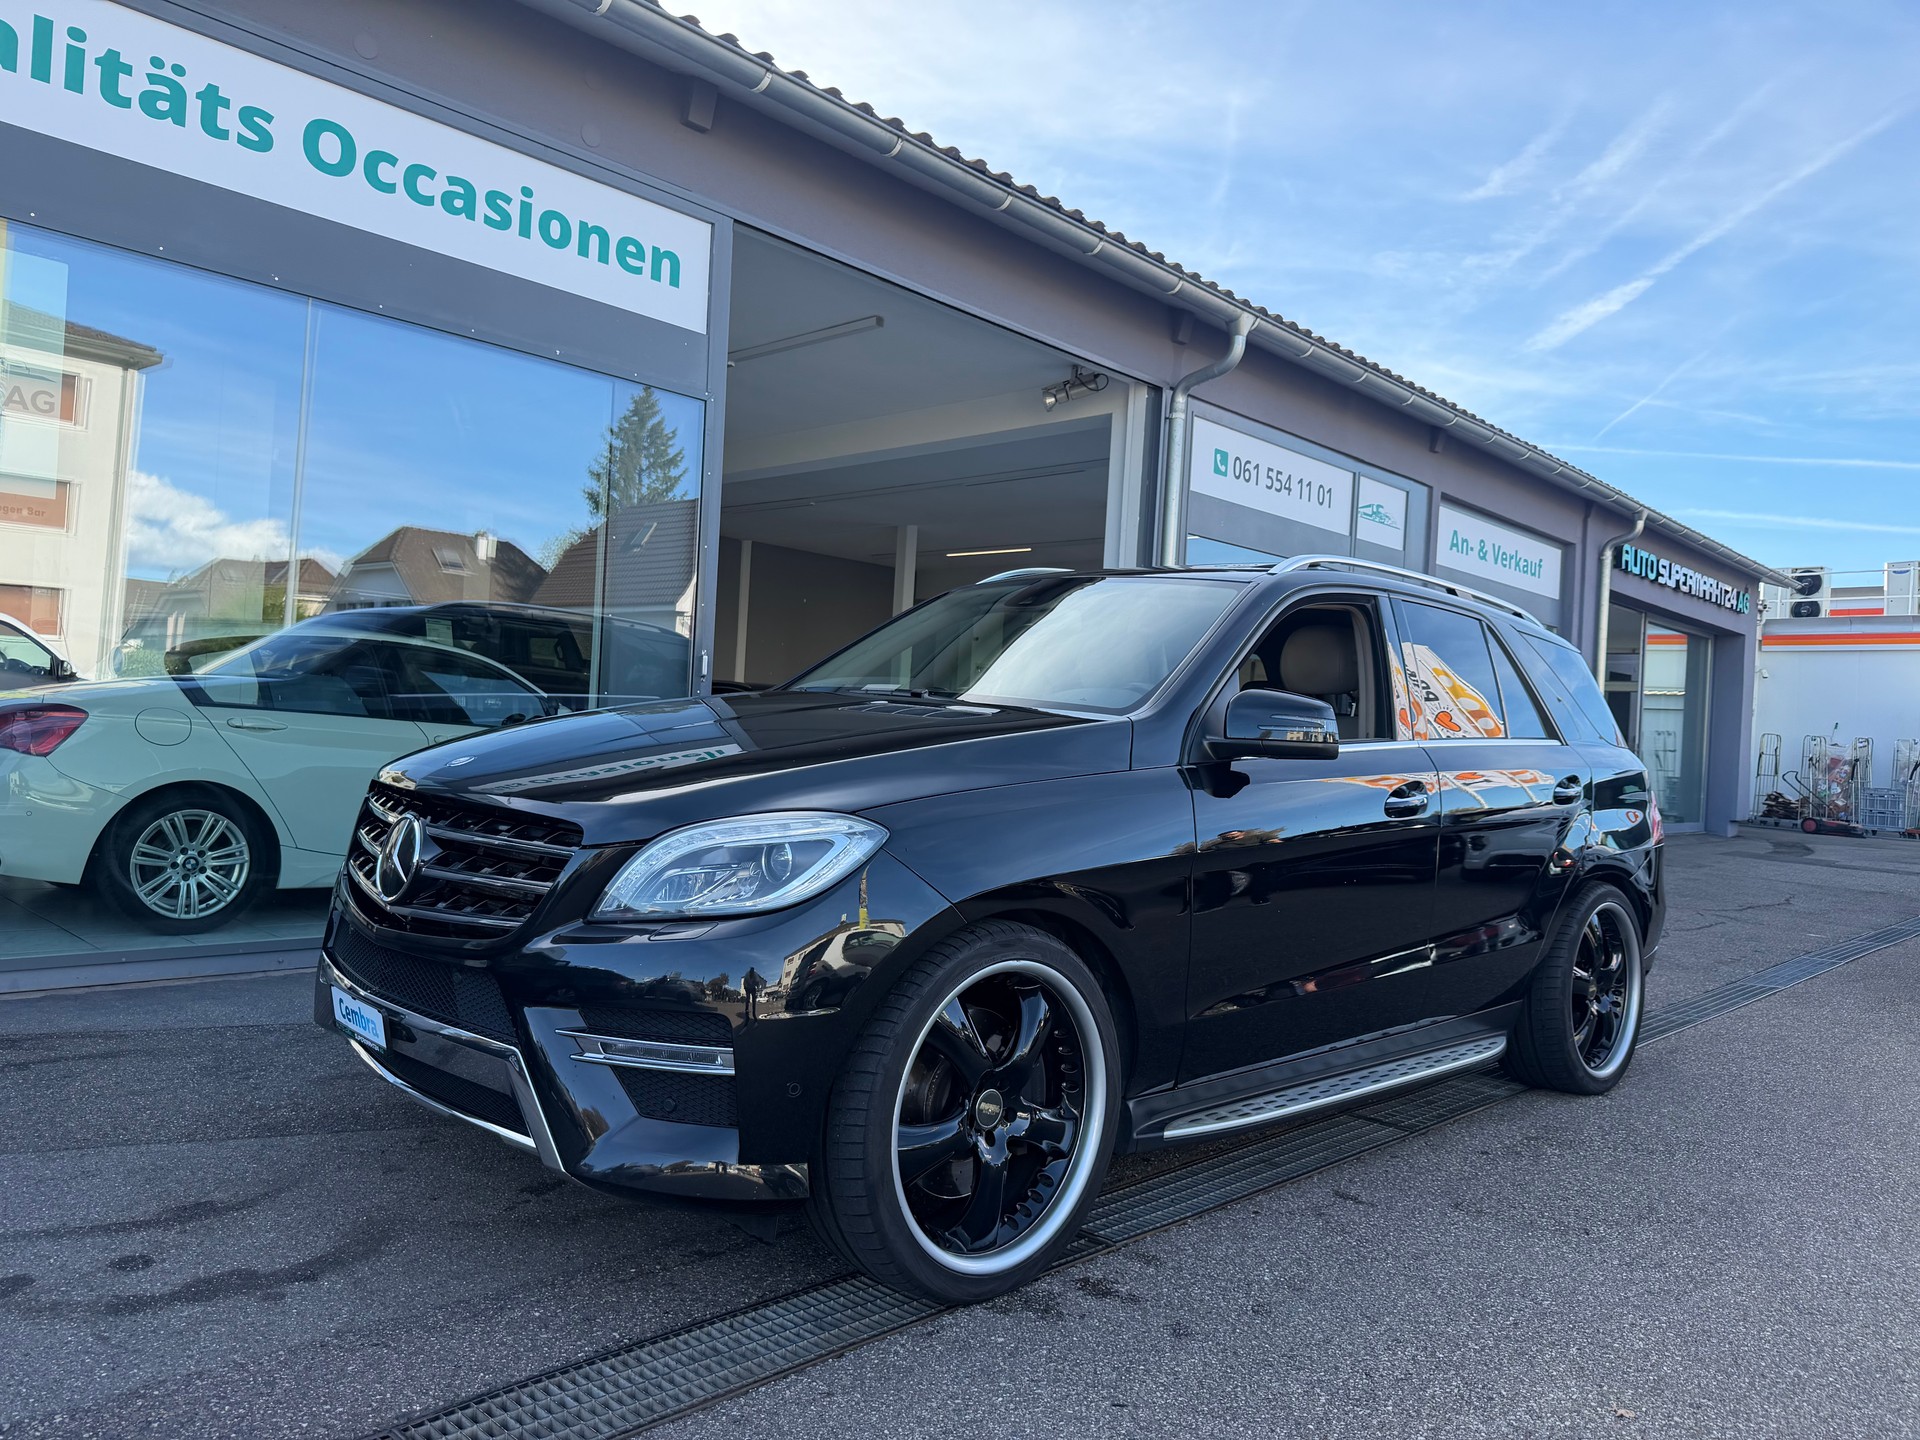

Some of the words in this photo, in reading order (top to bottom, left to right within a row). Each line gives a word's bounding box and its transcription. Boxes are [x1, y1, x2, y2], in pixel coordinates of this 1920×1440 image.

[302, 118, 682, 290] Occasionen
[2, 385, 56, 414] AG
[1233, 456, 1260, 486] 061
[1265, 466, 1293, 496] 554
[1297, 477, 1312, 502] 11
[1317, 484, 1332, 508] 01
[1449, 529, 1474, 556] An-
[1477, 538, 1488, 562] &
[1492, 542, 1543, 579] Verkauf
[1621, 543, 1657, 580] AUTO
[1658, 558, 1737, 610] SUPERMARKT24
[1737, 590, 1750, 615] AG
[338, 997, 379, 1039] Cembra
